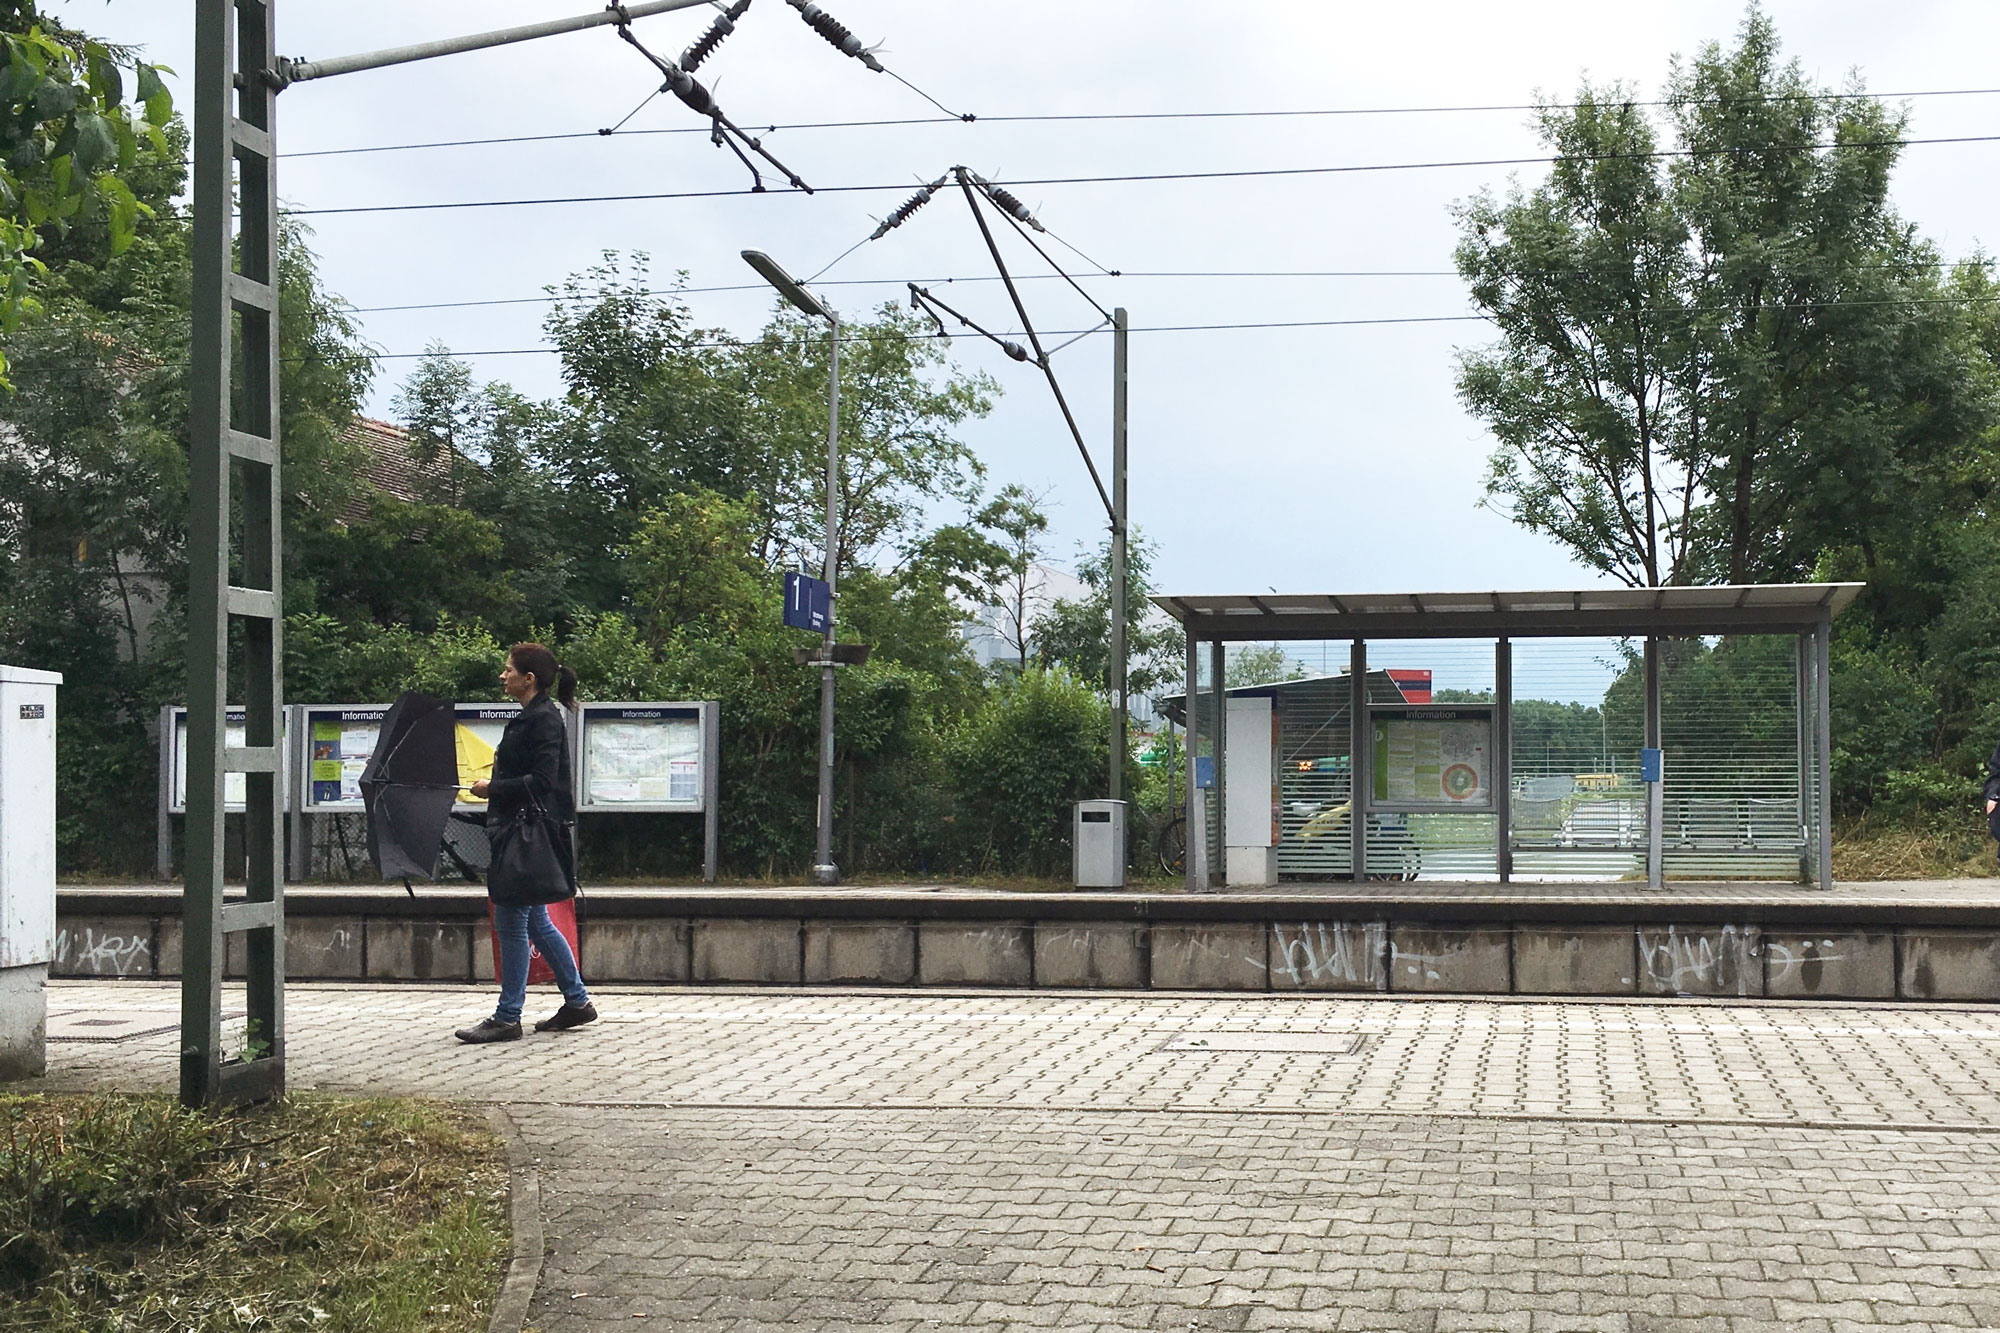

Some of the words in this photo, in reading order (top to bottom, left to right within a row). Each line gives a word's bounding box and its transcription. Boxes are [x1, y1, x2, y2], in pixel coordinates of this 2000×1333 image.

[793, 576, 800, 611] 1
[342, 711, 384, 720] Informatio
[479, 710, 521, 719] Informati
[622, 710, 661, 718] Information
[1406, 709, 1456, 719] Information
